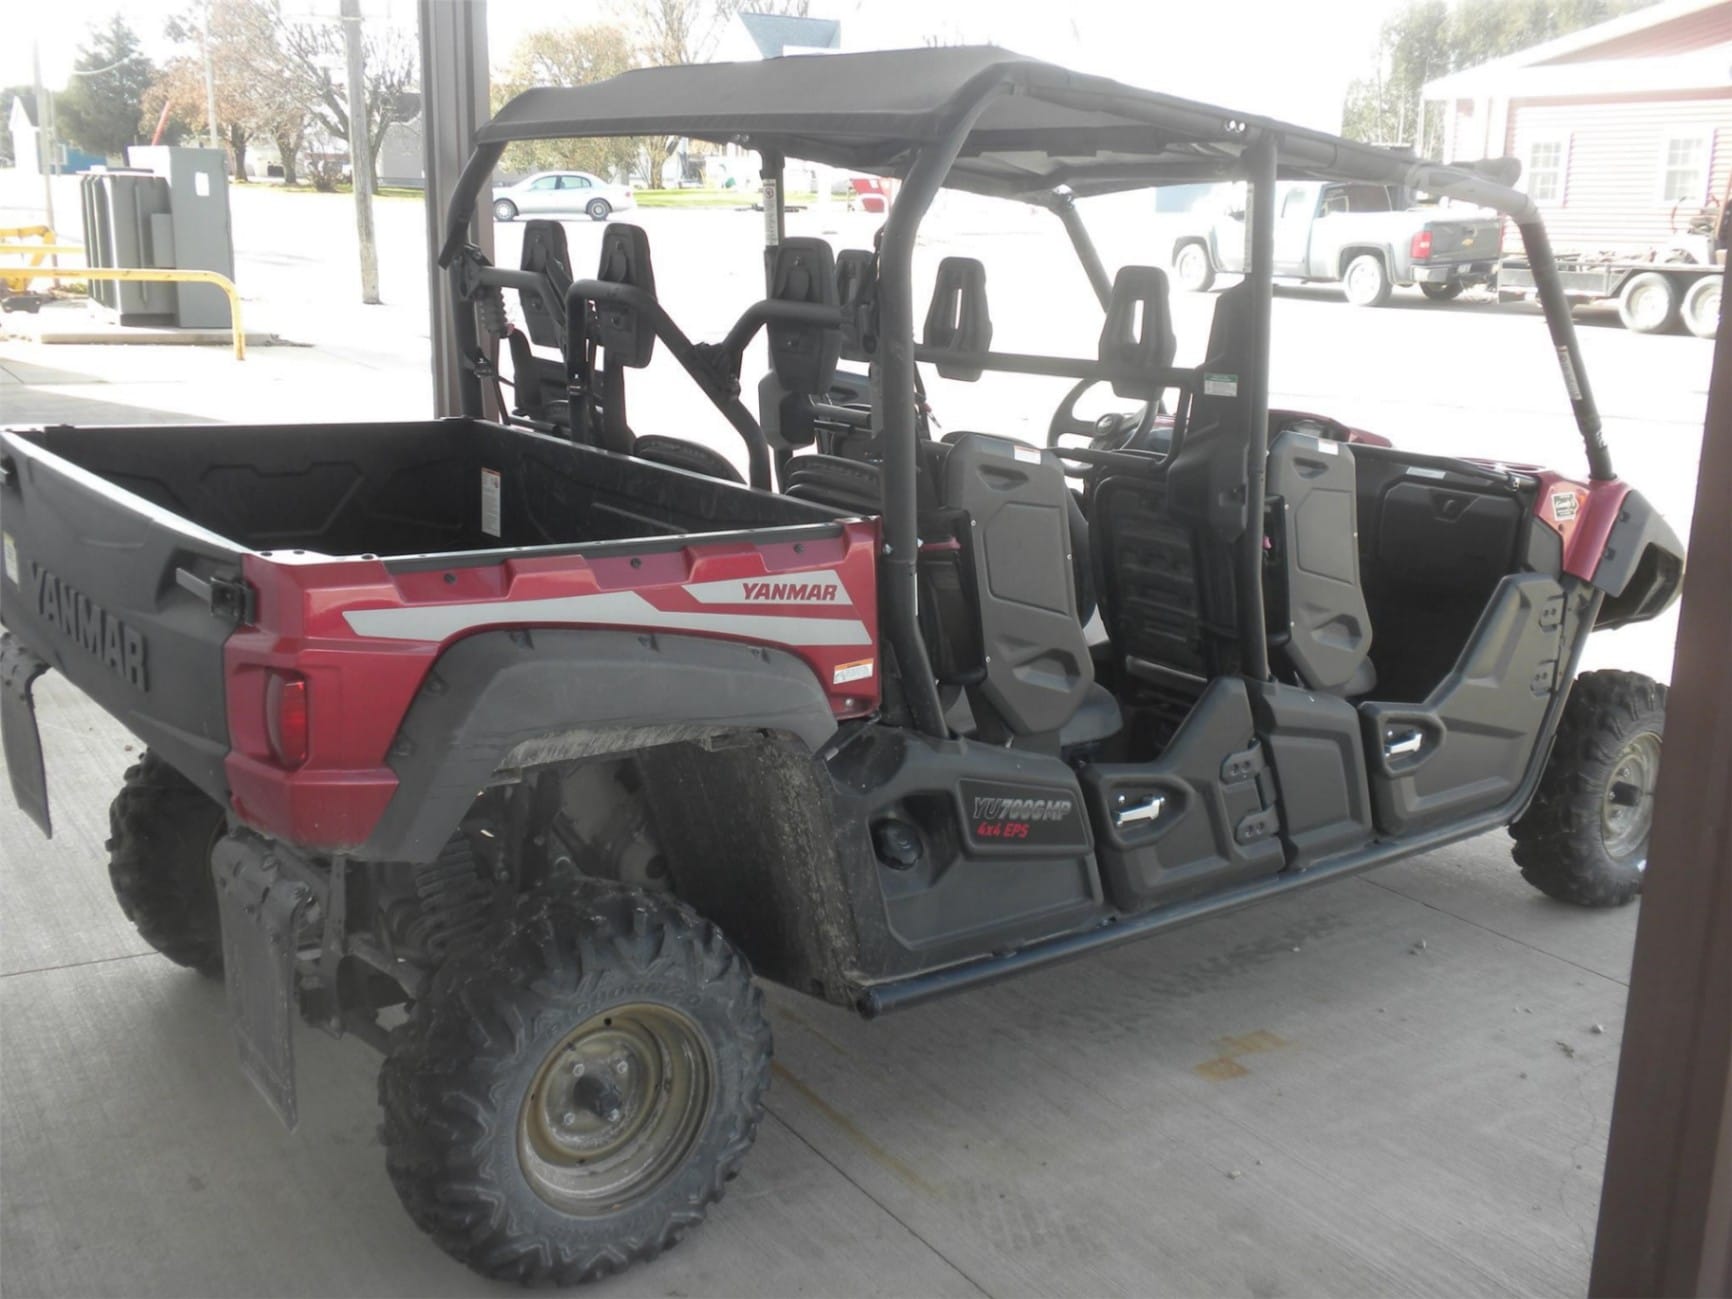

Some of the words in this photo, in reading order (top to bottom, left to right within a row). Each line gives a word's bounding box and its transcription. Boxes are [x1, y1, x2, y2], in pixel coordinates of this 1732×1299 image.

[742, 583, 838, 601] YANMAR
[27, 560, 150, 692] YANMAR
[976, 821, 1001, 837] 4x4
[1002, 822, 1031, 838] EPS
